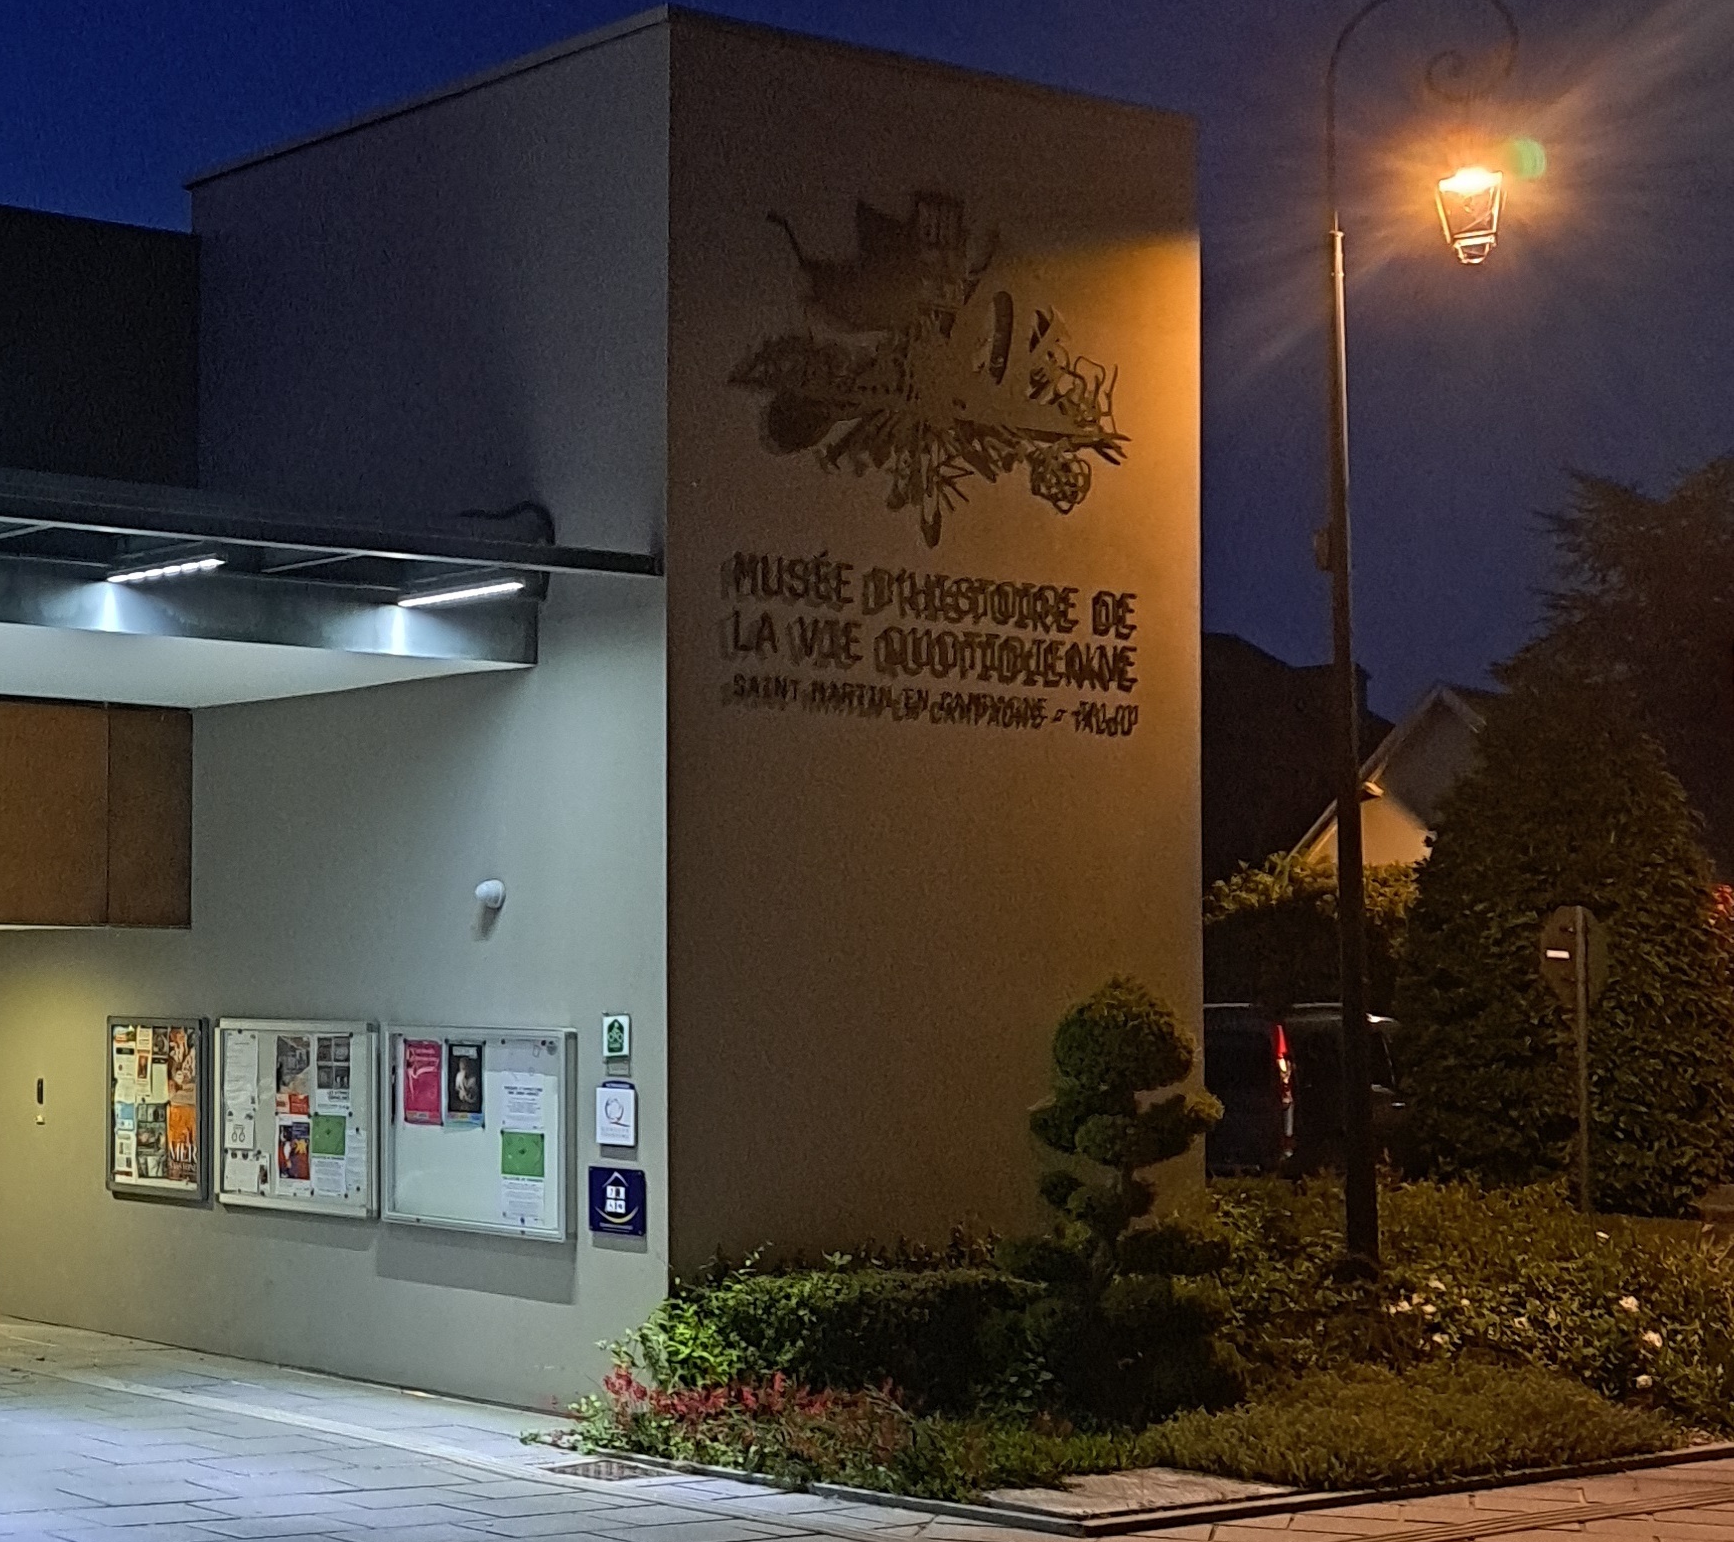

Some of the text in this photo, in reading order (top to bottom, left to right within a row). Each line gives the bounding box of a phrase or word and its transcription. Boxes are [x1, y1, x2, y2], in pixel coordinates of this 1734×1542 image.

[729, 550, 1138, 640] MUSÉE D'HISTOIRE DE
[731, 609, 1138, 692] LA VIE QUOTIDIENNE
